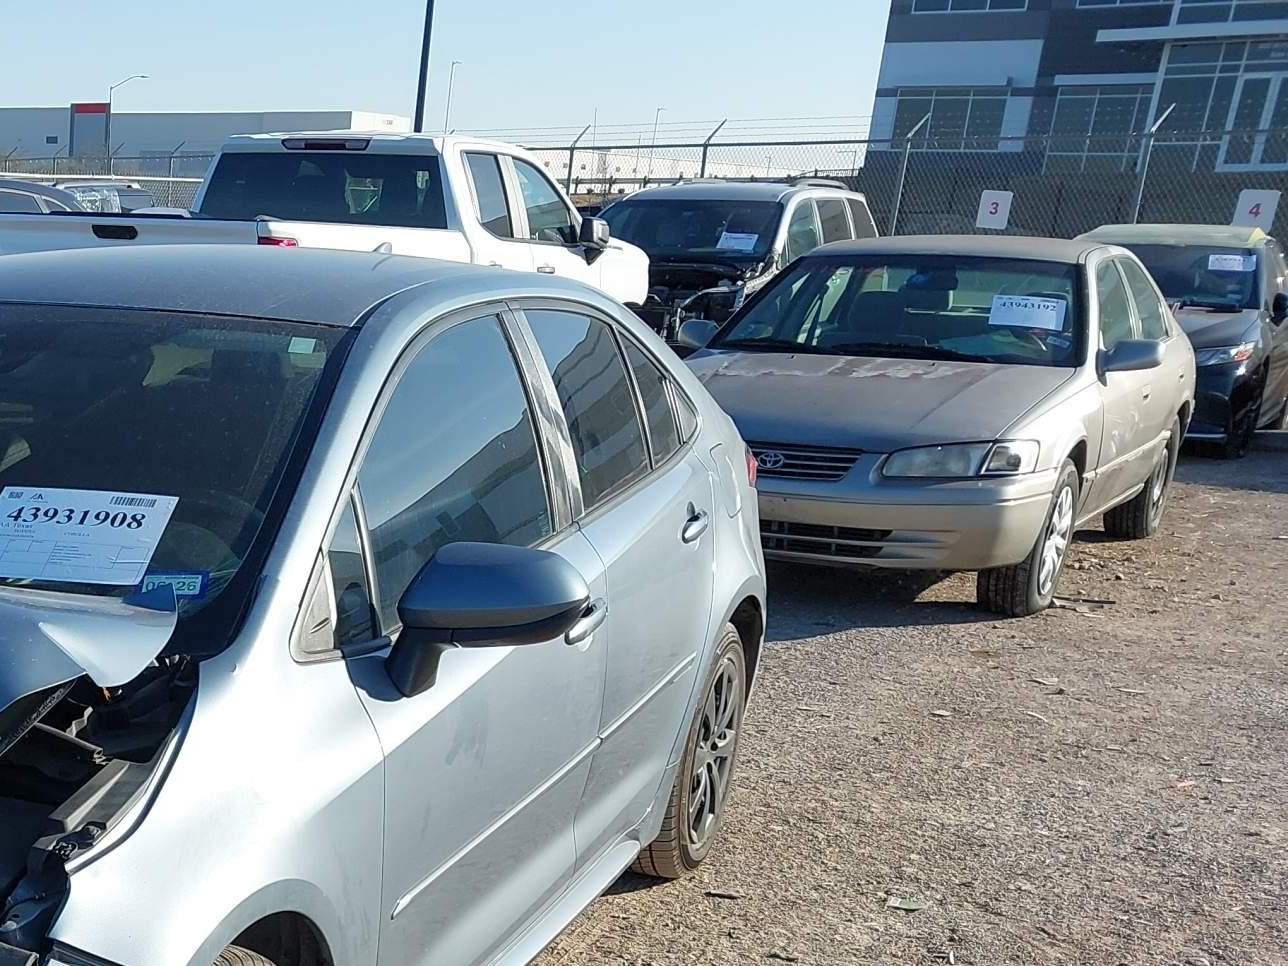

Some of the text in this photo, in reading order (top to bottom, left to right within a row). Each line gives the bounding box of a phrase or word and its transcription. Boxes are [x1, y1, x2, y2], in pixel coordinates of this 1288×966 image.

[988, 201, 1000, 216] 3
[1248, 202, 1262, 218] 4
[999, 301, 1057, 312] 43943192
[6, 505, 146, 530] 43931908
[175, 580, 197, 591] 26
